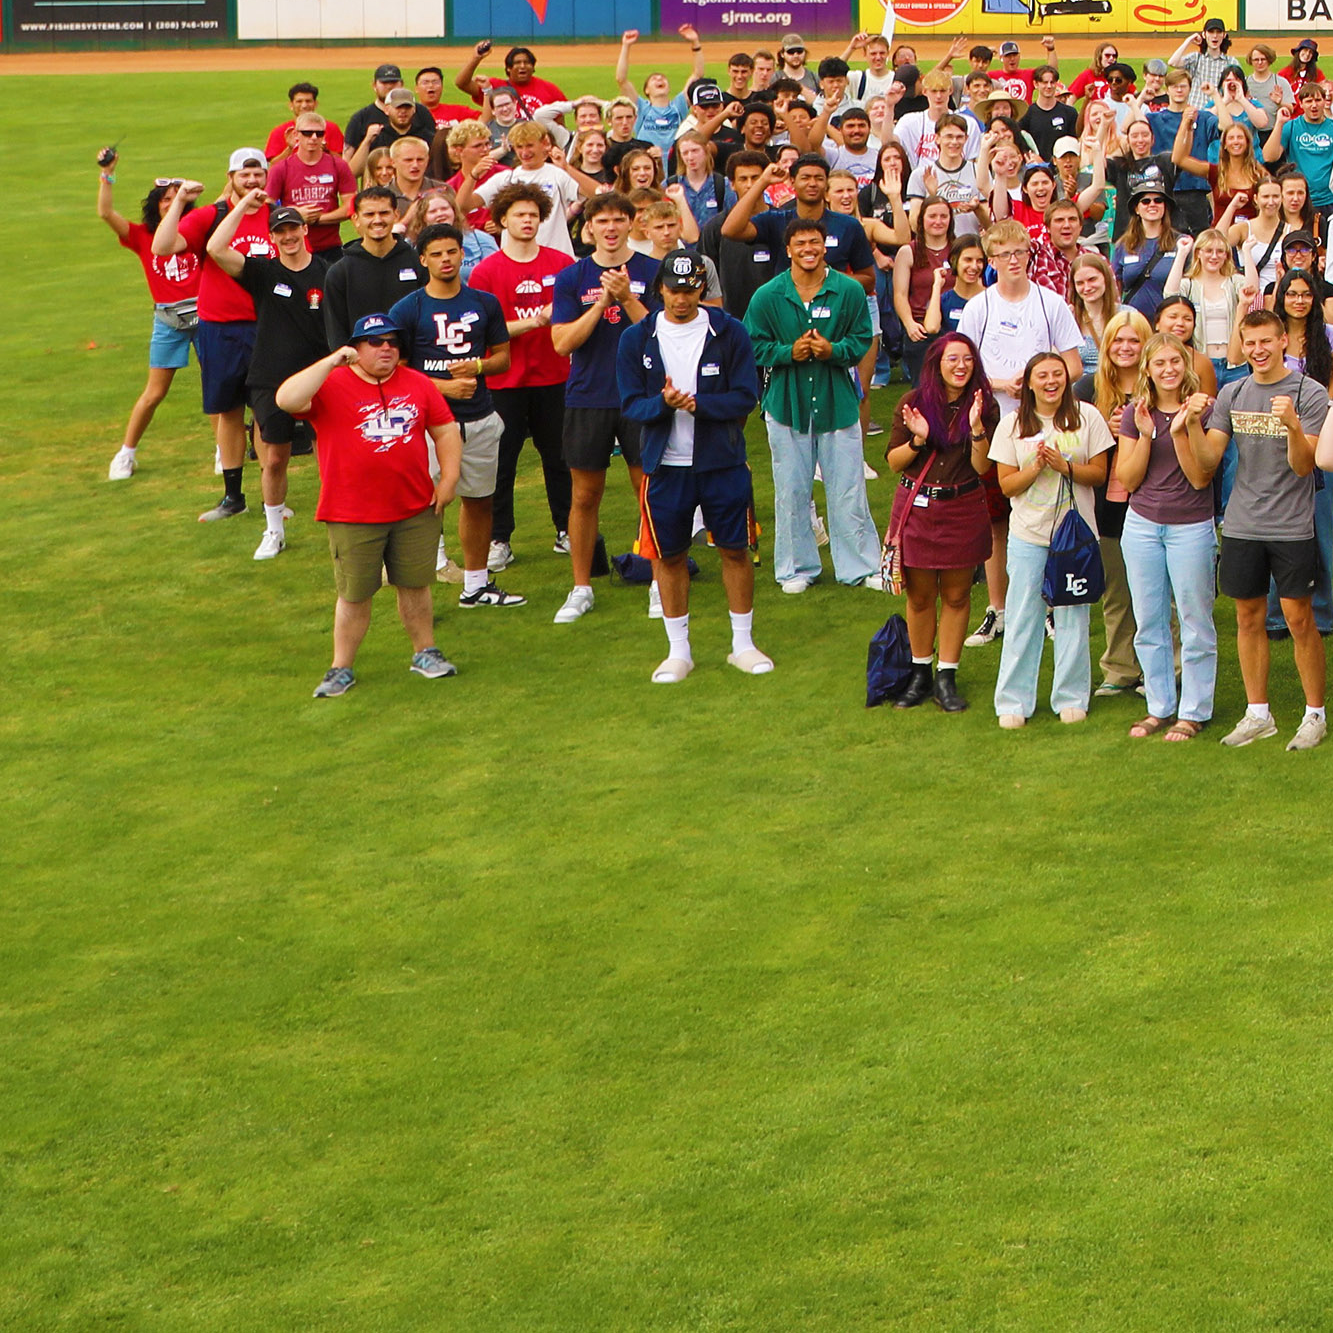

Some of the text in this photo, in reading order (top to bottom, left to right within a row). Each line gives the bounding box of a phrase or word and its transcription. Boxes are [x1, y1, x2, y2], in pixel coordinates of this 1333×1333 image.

[20, 21, 144, 32] WWW.FISHERSYSTEMS.COM
[721, 11, 792, 26] sjrmc.org
[433, 313, 473, 355] LC
[1065, 573, 1088, 596] LC
